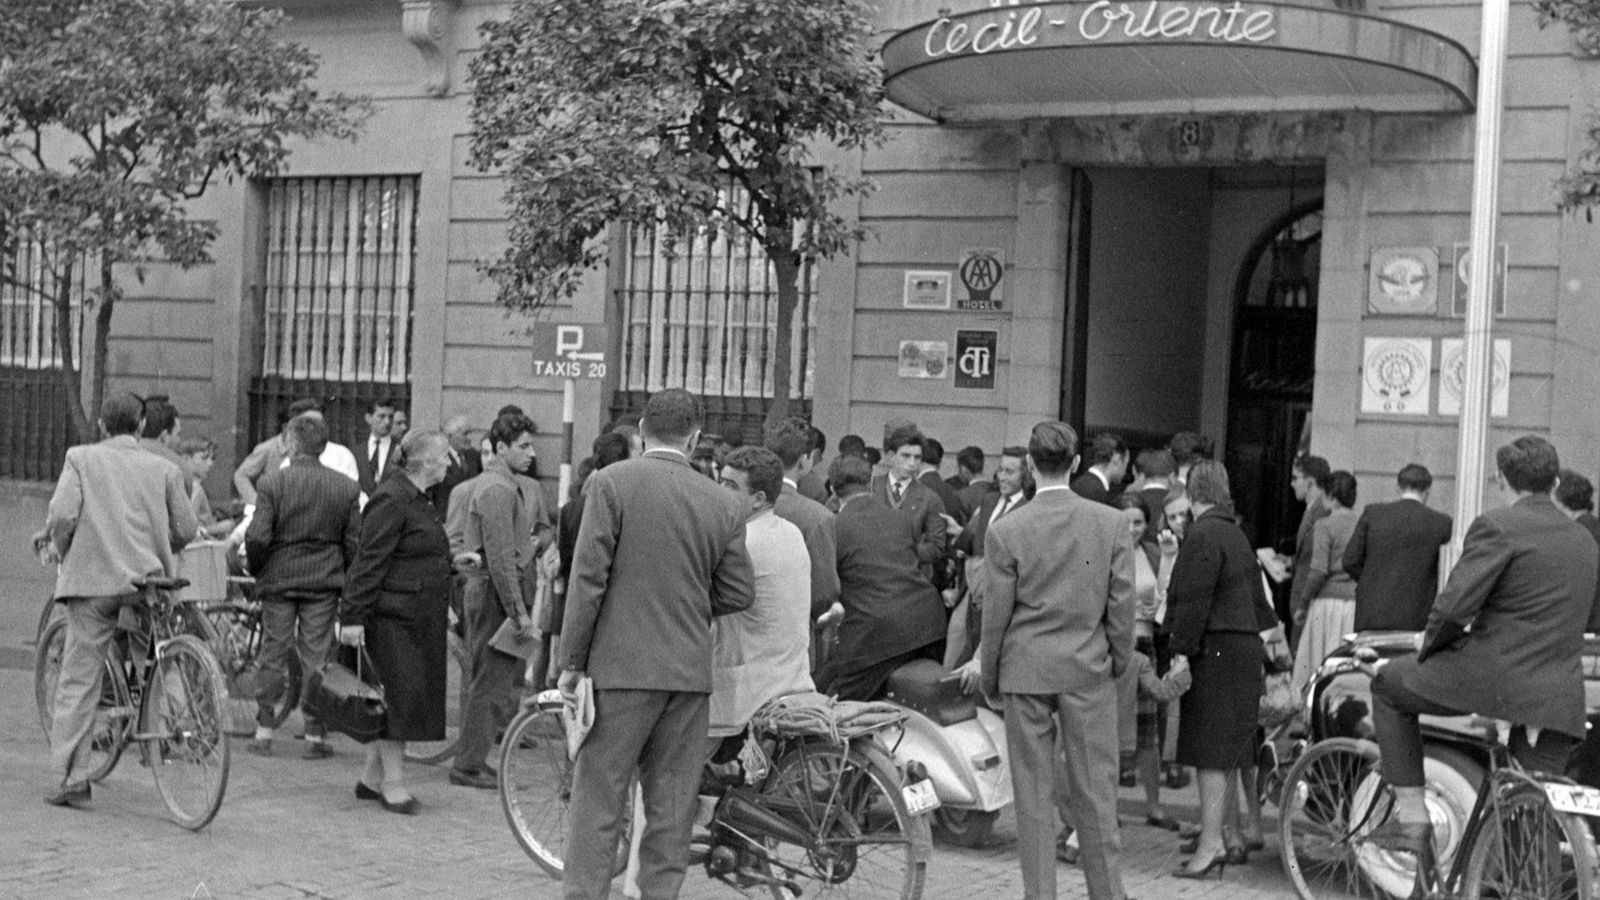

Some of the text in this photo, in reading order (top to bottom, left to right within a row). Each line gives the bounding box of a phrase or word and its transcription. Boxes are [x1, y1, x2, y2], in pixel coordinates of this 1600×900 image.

[925, 7, 1041, 56] Cecil
[963, 300, 996, 310] HOTEL
[556, 325, 583, 356] P
[533, 360, 607, 378] TAXIS 20
